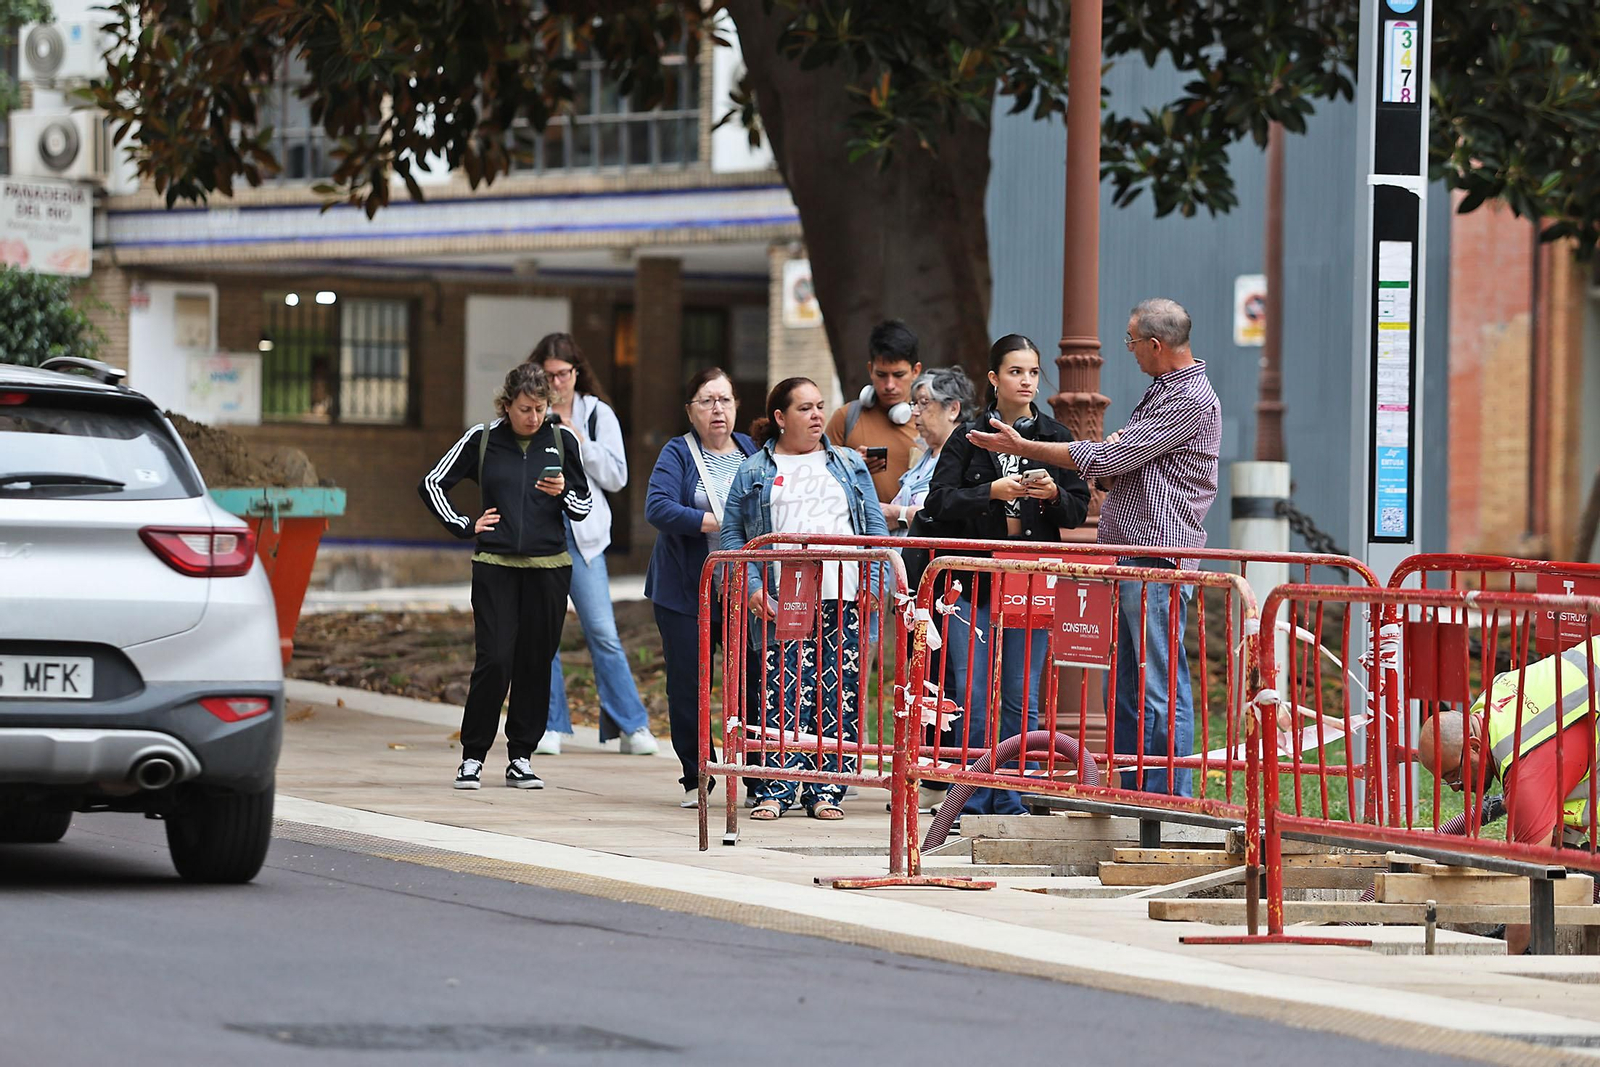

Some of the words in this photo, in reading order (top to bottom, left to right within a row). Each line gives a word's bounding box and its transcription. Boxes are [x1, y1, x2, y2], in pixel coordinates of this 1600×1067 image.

[1402, 30, 1412, 49] 3
[1400, 50, 1412, 68] 4
[1401, 69, 1412, 87] 7
[1400, 88, 1411, 103] 8
[1002, 594, 1056, 607] CONST
[1062, 622, 1100, 635] CONSTRUYA
[24, 663, 79, 692] MFK
